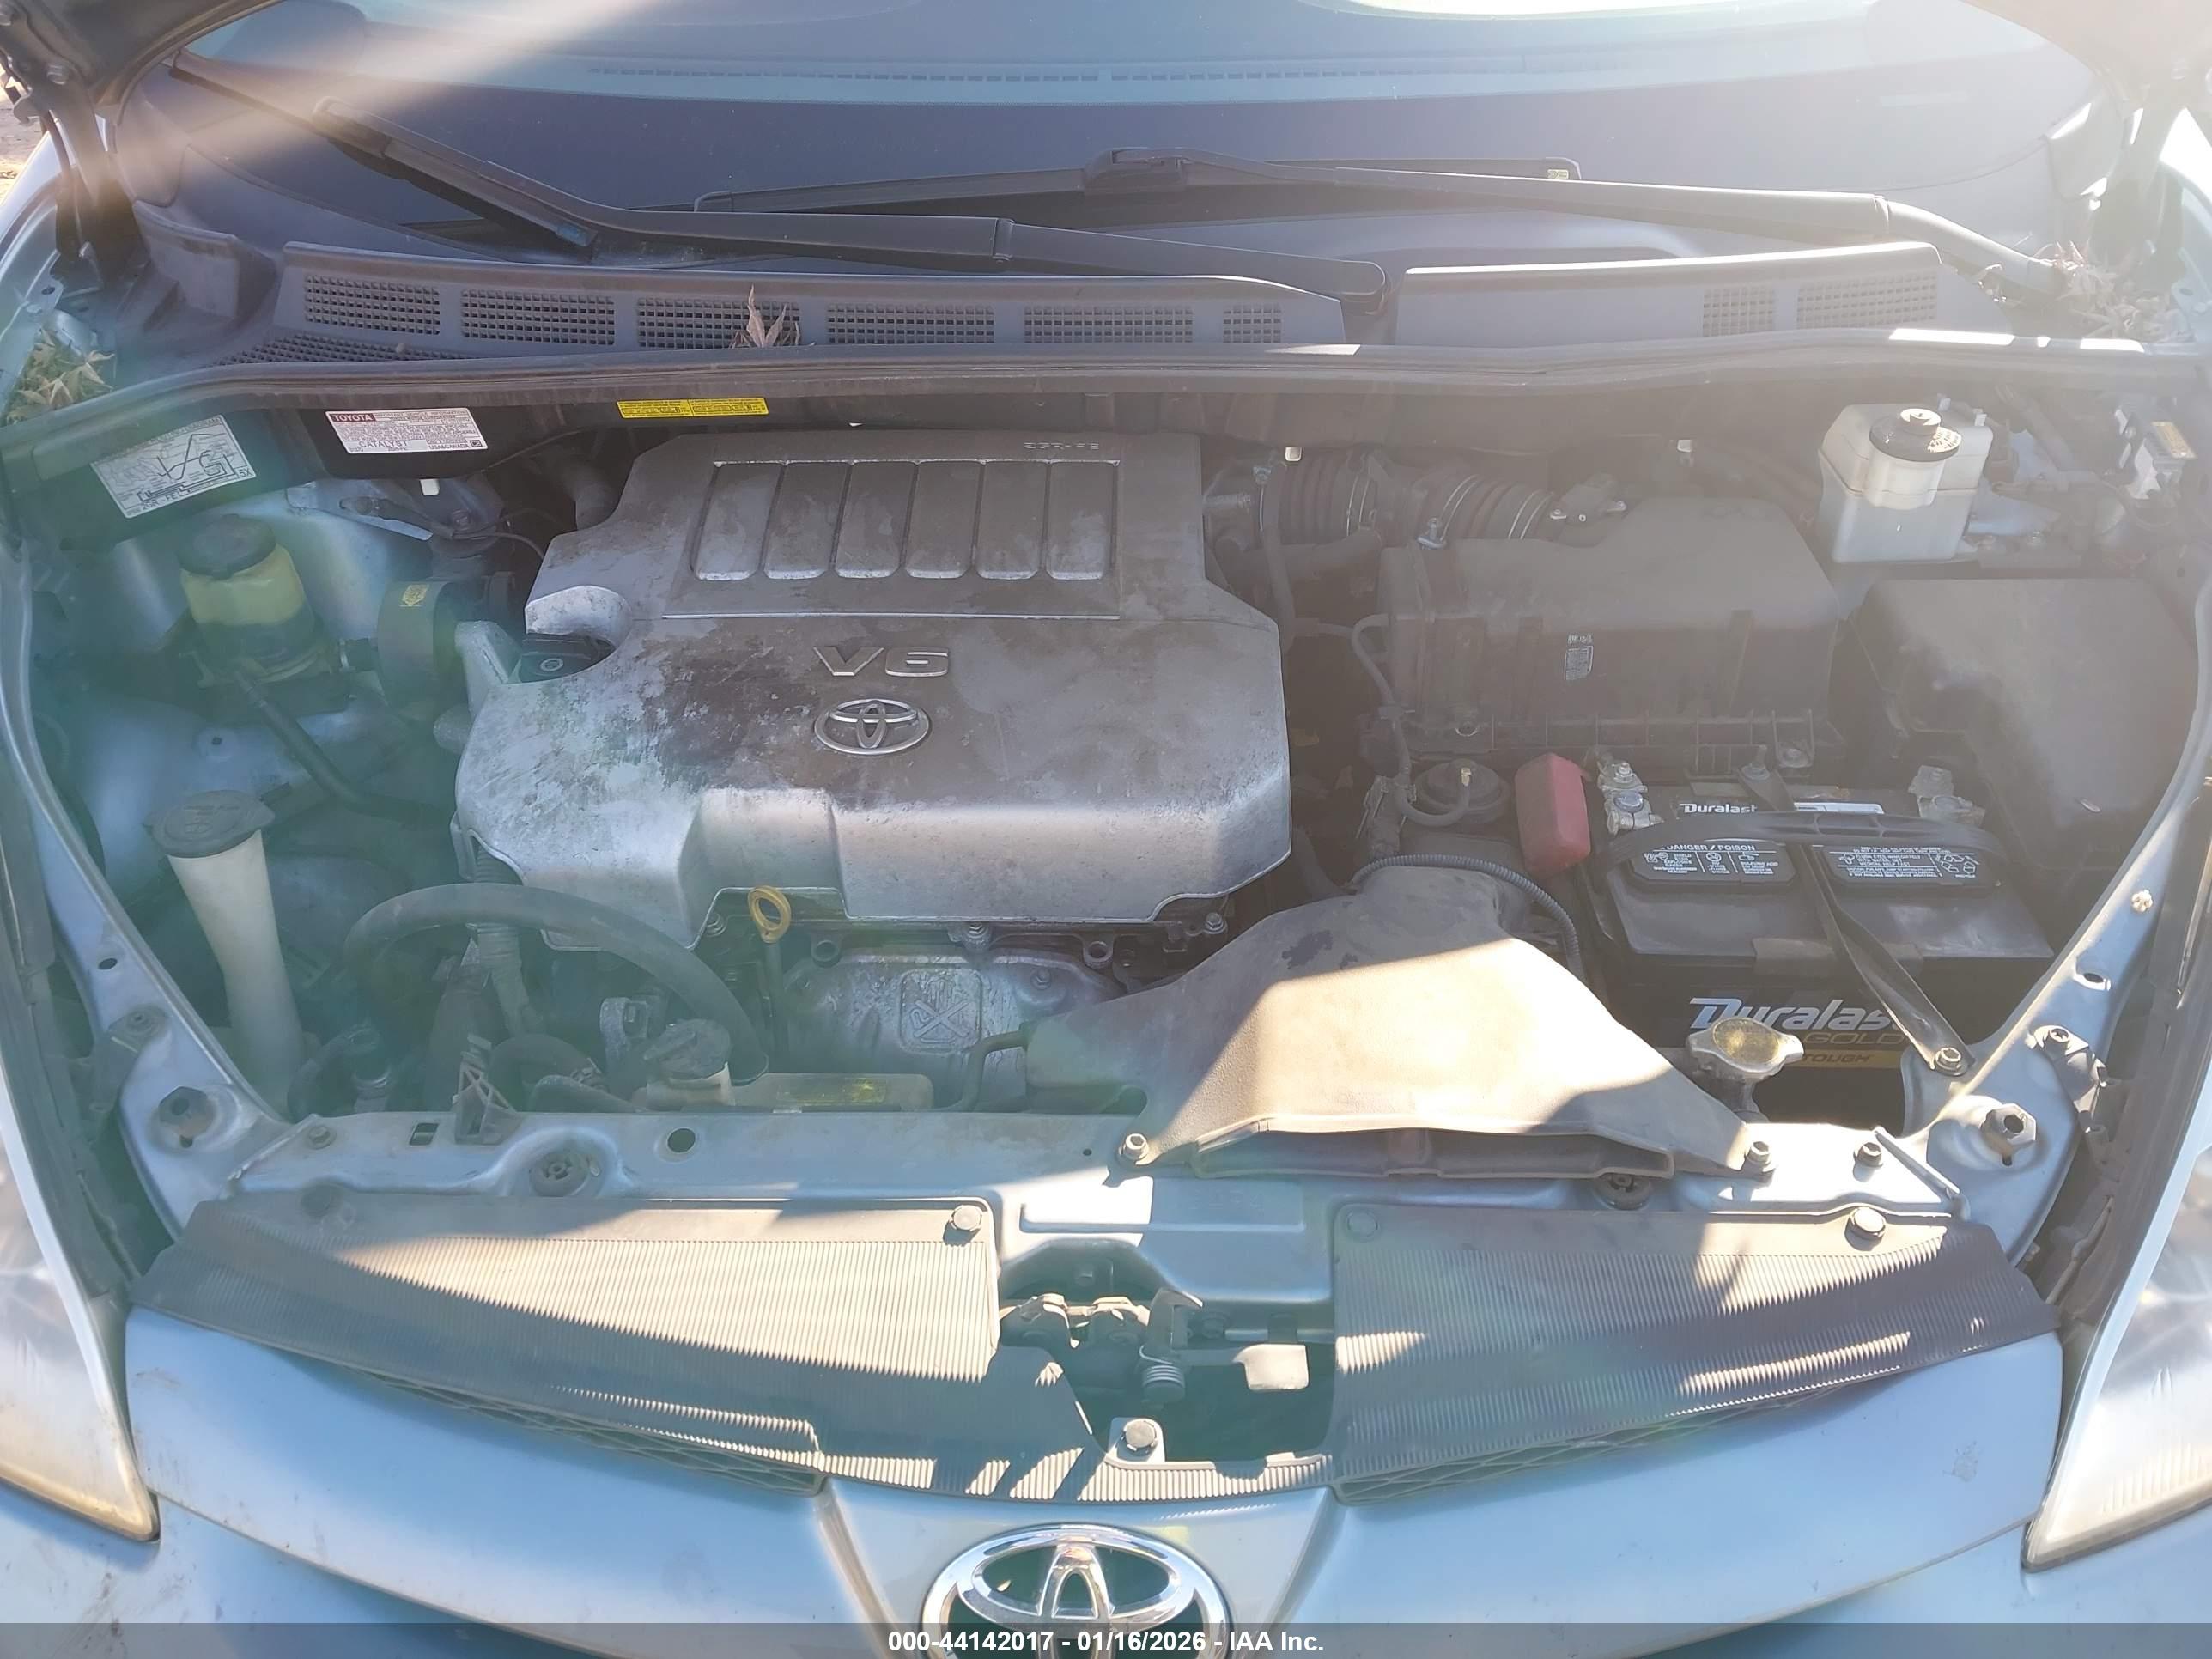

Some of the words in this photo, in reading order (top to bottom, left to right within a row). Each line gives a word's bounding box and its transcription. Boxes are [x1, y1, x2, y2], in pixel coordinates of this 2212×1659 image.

[812, 645, 949, 678] V6
[1679, 803, 1759, 814] Duralast
[1689, 997, 1900, 1031] Duralas
[1804, 1032, 1905, 1045] GOLD
[1802, 1054, 1875, 1063] TOUGH
